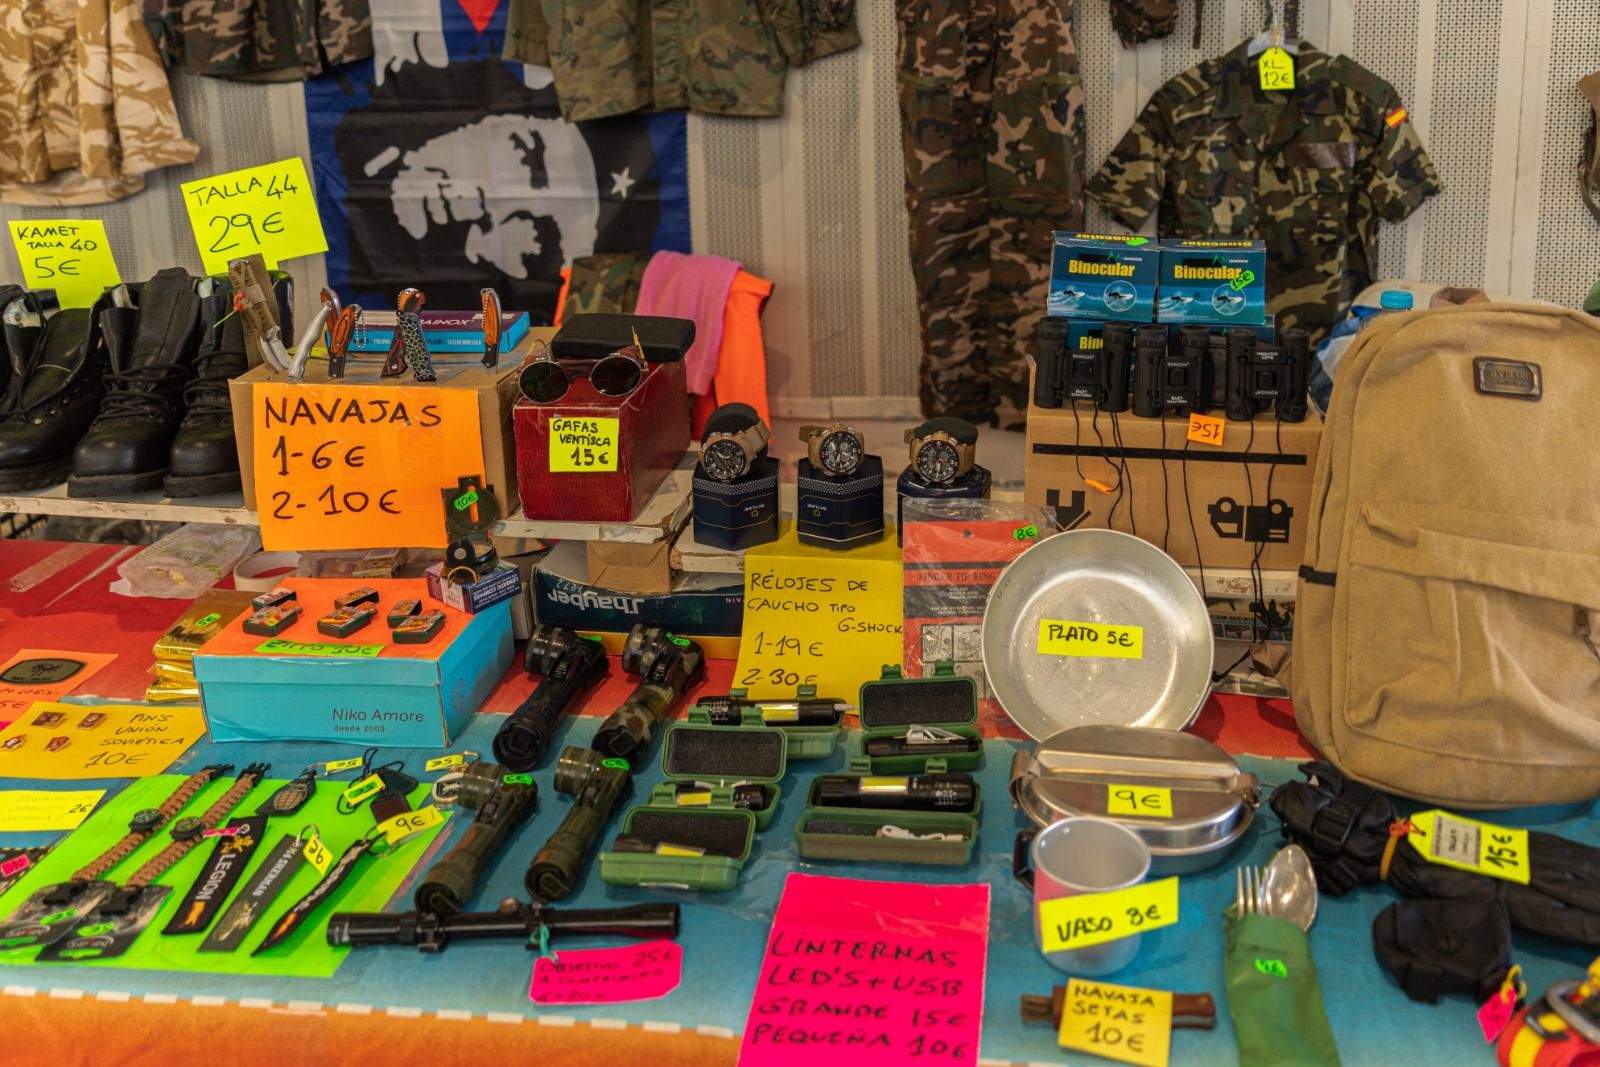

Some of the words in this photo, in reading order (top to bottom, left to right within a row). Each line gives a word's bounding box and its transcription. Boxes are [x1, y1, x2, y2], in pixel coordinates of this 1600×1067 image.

[1263, 60, 1285, 69] XL
[1264, 72, 1290, 86] 12€
[189, 178, 263, 206] TALLA
[266, 174, 297, 199] 44
[17, 226, 80, 239] KAMET
[208, 212, 285, 252] 29€
[27, 241, 64, 249] TALLA
[70, 240, 97, 251] 40
[34, 256, 81, 278] 5€
[1068, 259, 1136, 277] Binocular
[1174, 265, 1242, 280] Binocular
[1231, 272, 1254, 289] 15€
[264, 397, 442, 428] NAVAJAS
[552, 419, 599, 434] GAFAS
[1191, 420, 1221, 439] 15€
[570, 446, 609, 466] 15€
[455, 492, 478, 510] 10€
[847, 580, 868, 591] DE
[747, 598, 819, 612] CAUCHO
[830, 603, 856, 613] TIPO
[838, 617, 902, 634] G-SHOCK
[1048, 624, 1099, 642] PLATO
[1107, 631, 1134, 647] 5€
[333, 709, 366, 721] Niko
[371, 709, 424, 722] Amore
[1115, 790, 1161, 809] 9€
[395, 815, 426, 831] 9€
[1484, 833, 1520, 869] 15€
[195, 853, 237, 900] LEGION
[1056, 917, 1113, 942] VASO
[1126, 904, 1161, 926] 3€
[771, 932, 960, 968] LINTERNAS
[1073, 986, 1156, 1008] NAVAJA
[758, 997, 889, 1018] GRANDE
[912, 1008, 967, 1027] 15€
[1072, 1001, 1145, 1024] SETAS
[1086, 1022, 1144, 1052] 10€
[908, 1035, 971, 1059] 10€
